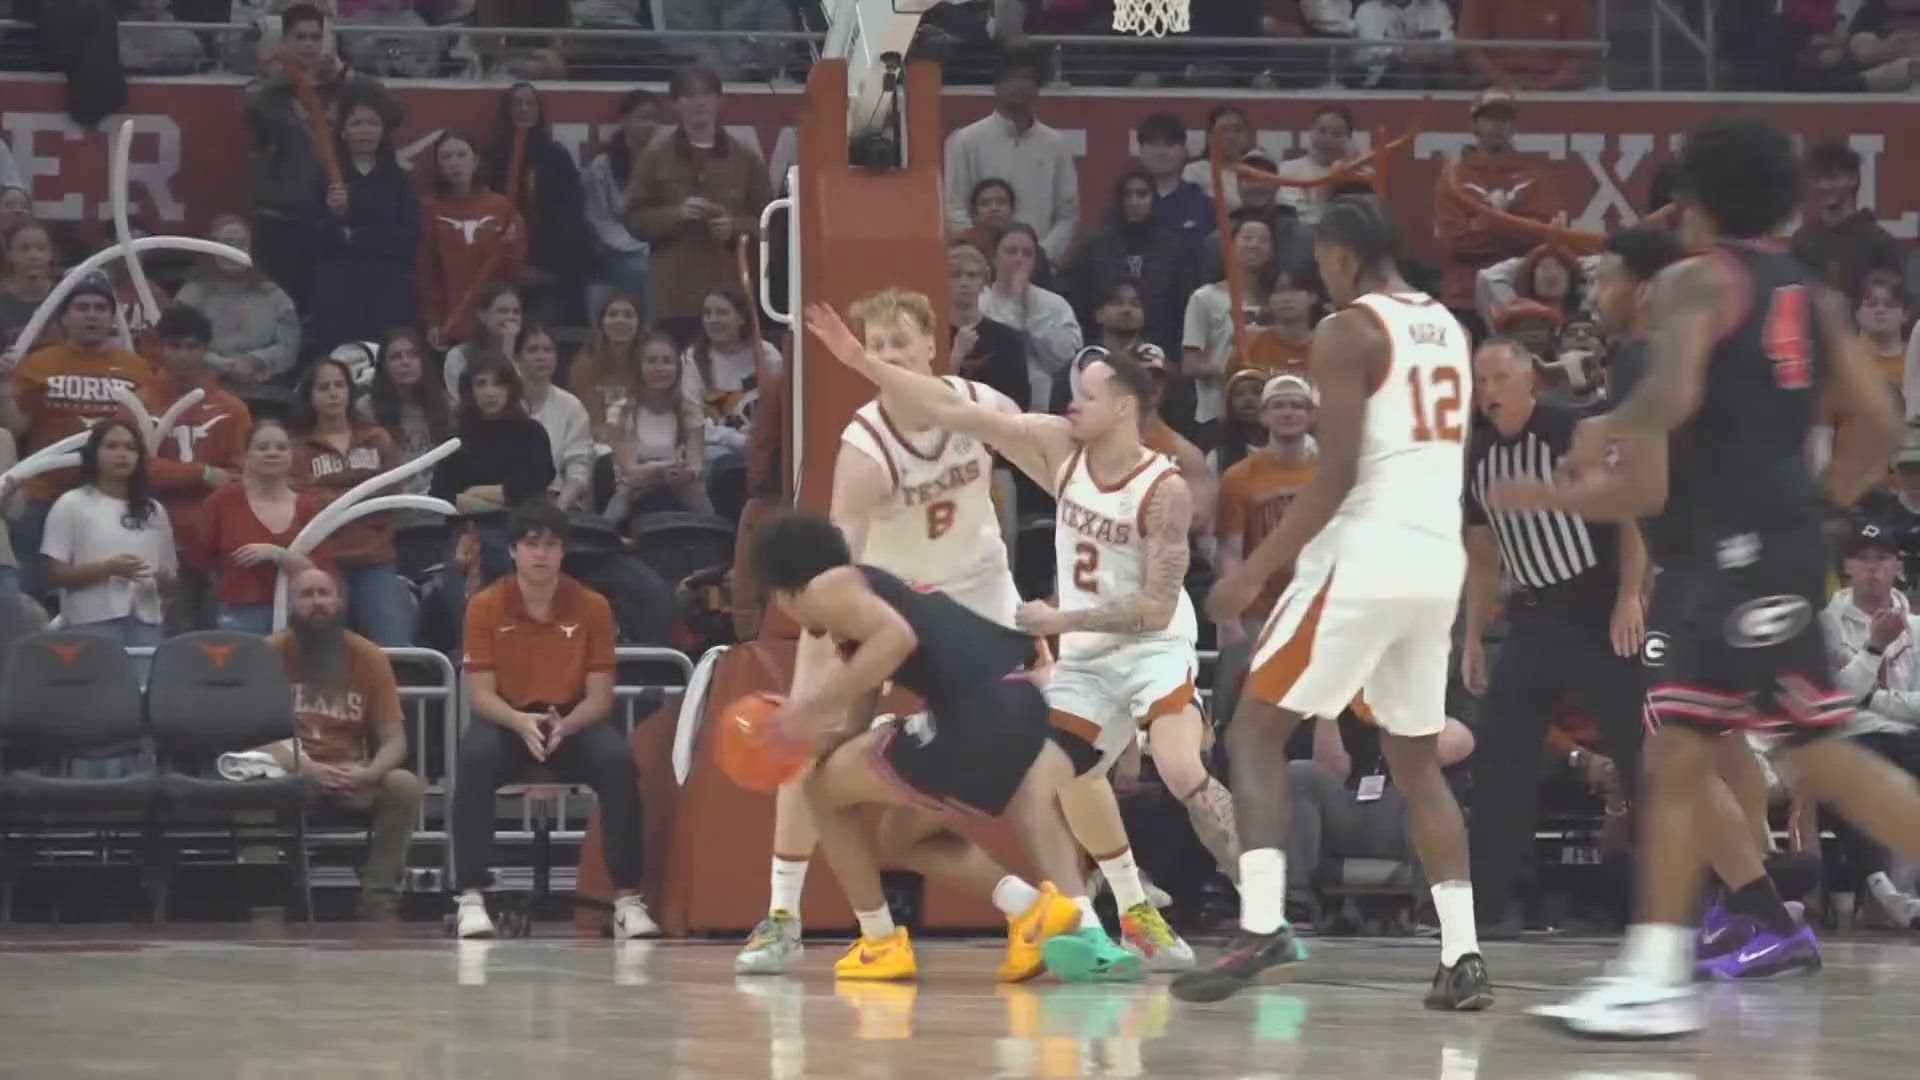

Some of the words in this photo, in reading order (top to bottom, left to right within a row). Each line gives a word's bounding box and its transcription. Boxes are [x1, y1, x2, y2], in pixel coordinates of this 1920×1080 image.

[1763, 285, 1814, 388] 4
[1407, 366, 1463, 443] 12
[903, 459, 980, 506] TEXAS
[1062, 498, 1131, 545] TEXAS
[1073, 543, 1099, 593] 2
